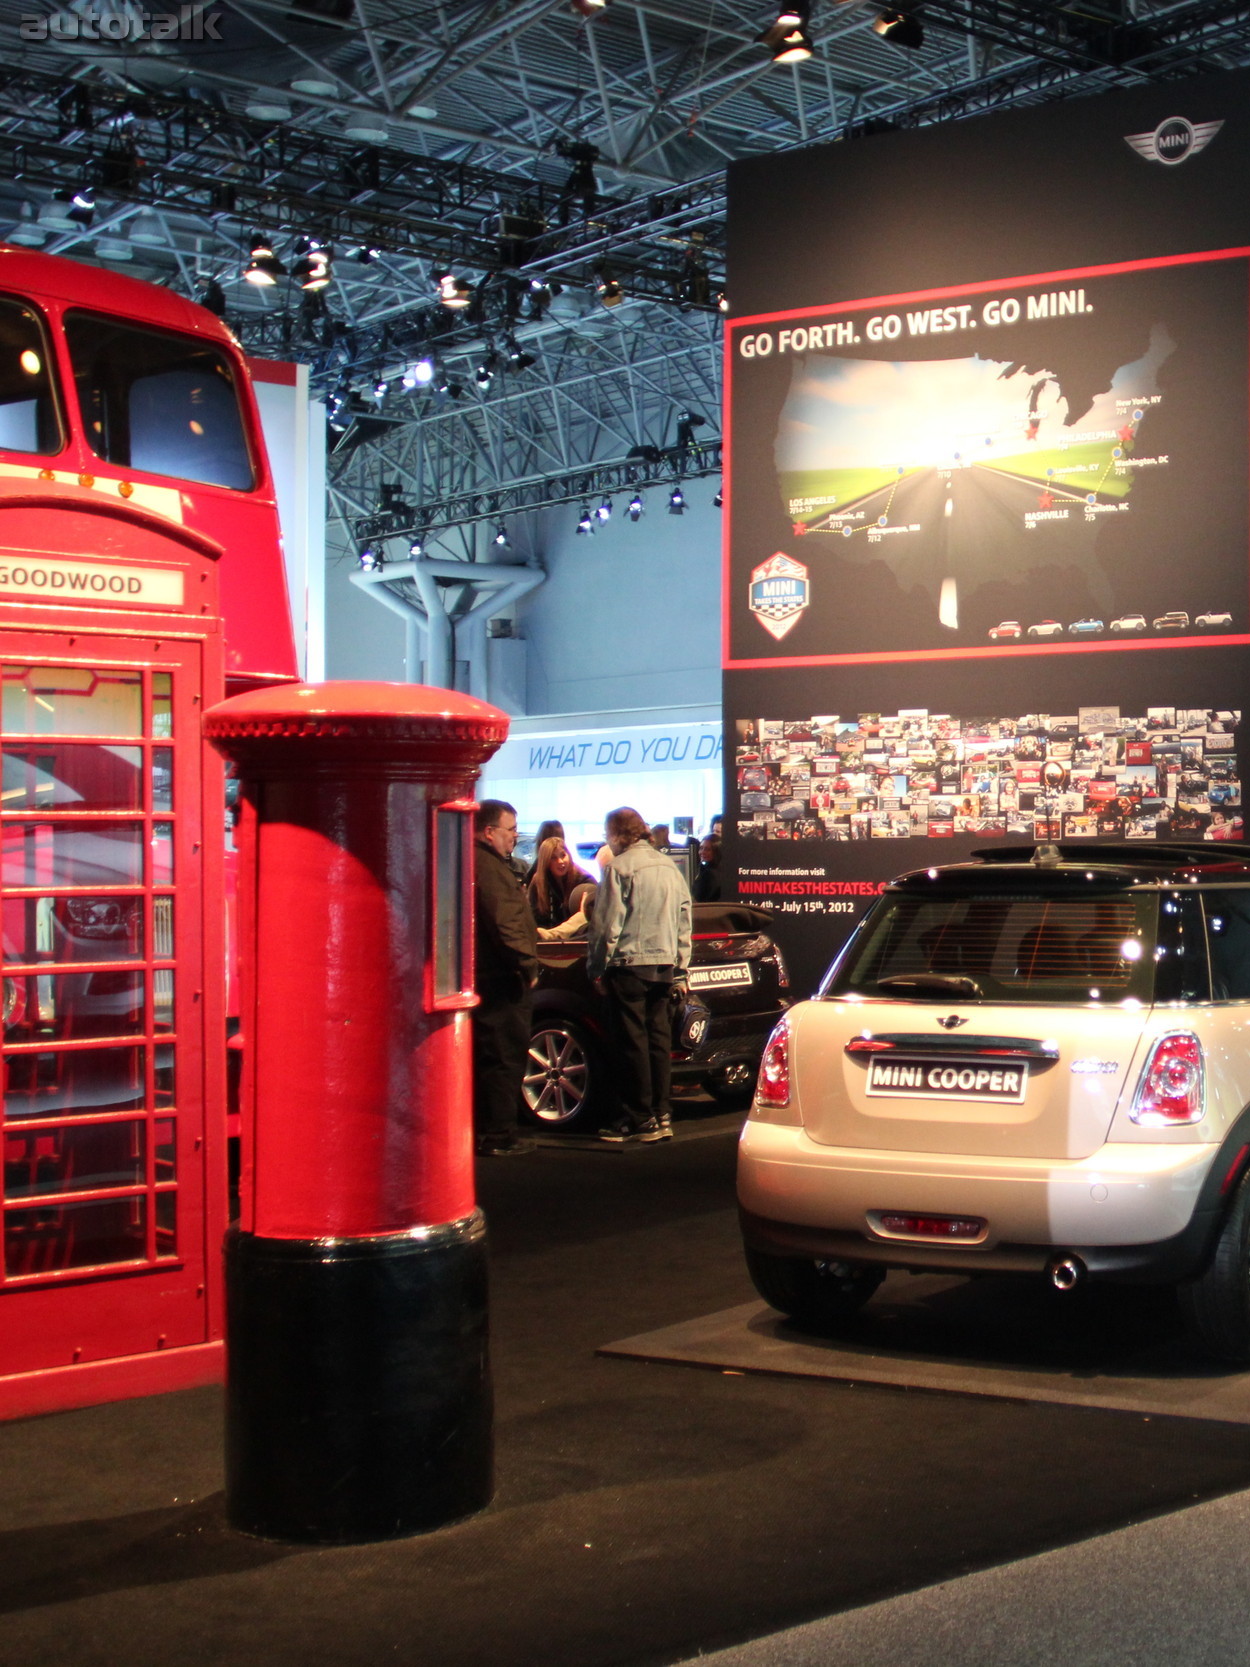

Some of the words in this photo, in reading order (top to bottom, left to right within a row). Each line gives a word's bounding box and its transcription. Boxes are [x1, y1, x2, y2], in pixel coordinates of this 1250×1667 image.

[1159, 133, 1189, 148] MINI
[740, 332, 772, 358] GO
[779, 321, 860, 352] FORTH.
[866, 314, 902, 341] GO
[906, 305, 977, 336] WEST.
[982, 298, 1020, 325] GO
[1027, 289, 1093, 320] MINI.
[790, 498, 803, 507] LOS
[804, 496, 836, 505] ANGELES
[1119, 502, 1129, 511] NC
[1024, 510, 1069, 521] NASHVILLE
[0, 566, 142, 594] GOODWOOD
[763, 580, 796, 596] MINI
[529, 743, 592, 770] WHAT
[596, 740, 630, 766] DO
[641, 736, 691, 763] YOU
[769, 868, 809, 876] information
[810, 868, 825, 876] visit
[781, 901, 801, 914] July
[804, 901, 826, 914] 15th,
[828, 902, 854, 912] 2012
[689, 972, 709, 983] MINI
[710, 969, 742, 981] COOPER
[742, 968, 748, 978] S
[873, 1066, 922, 1087] MINI
[928, 1068, 1018, 1092] COOPER
